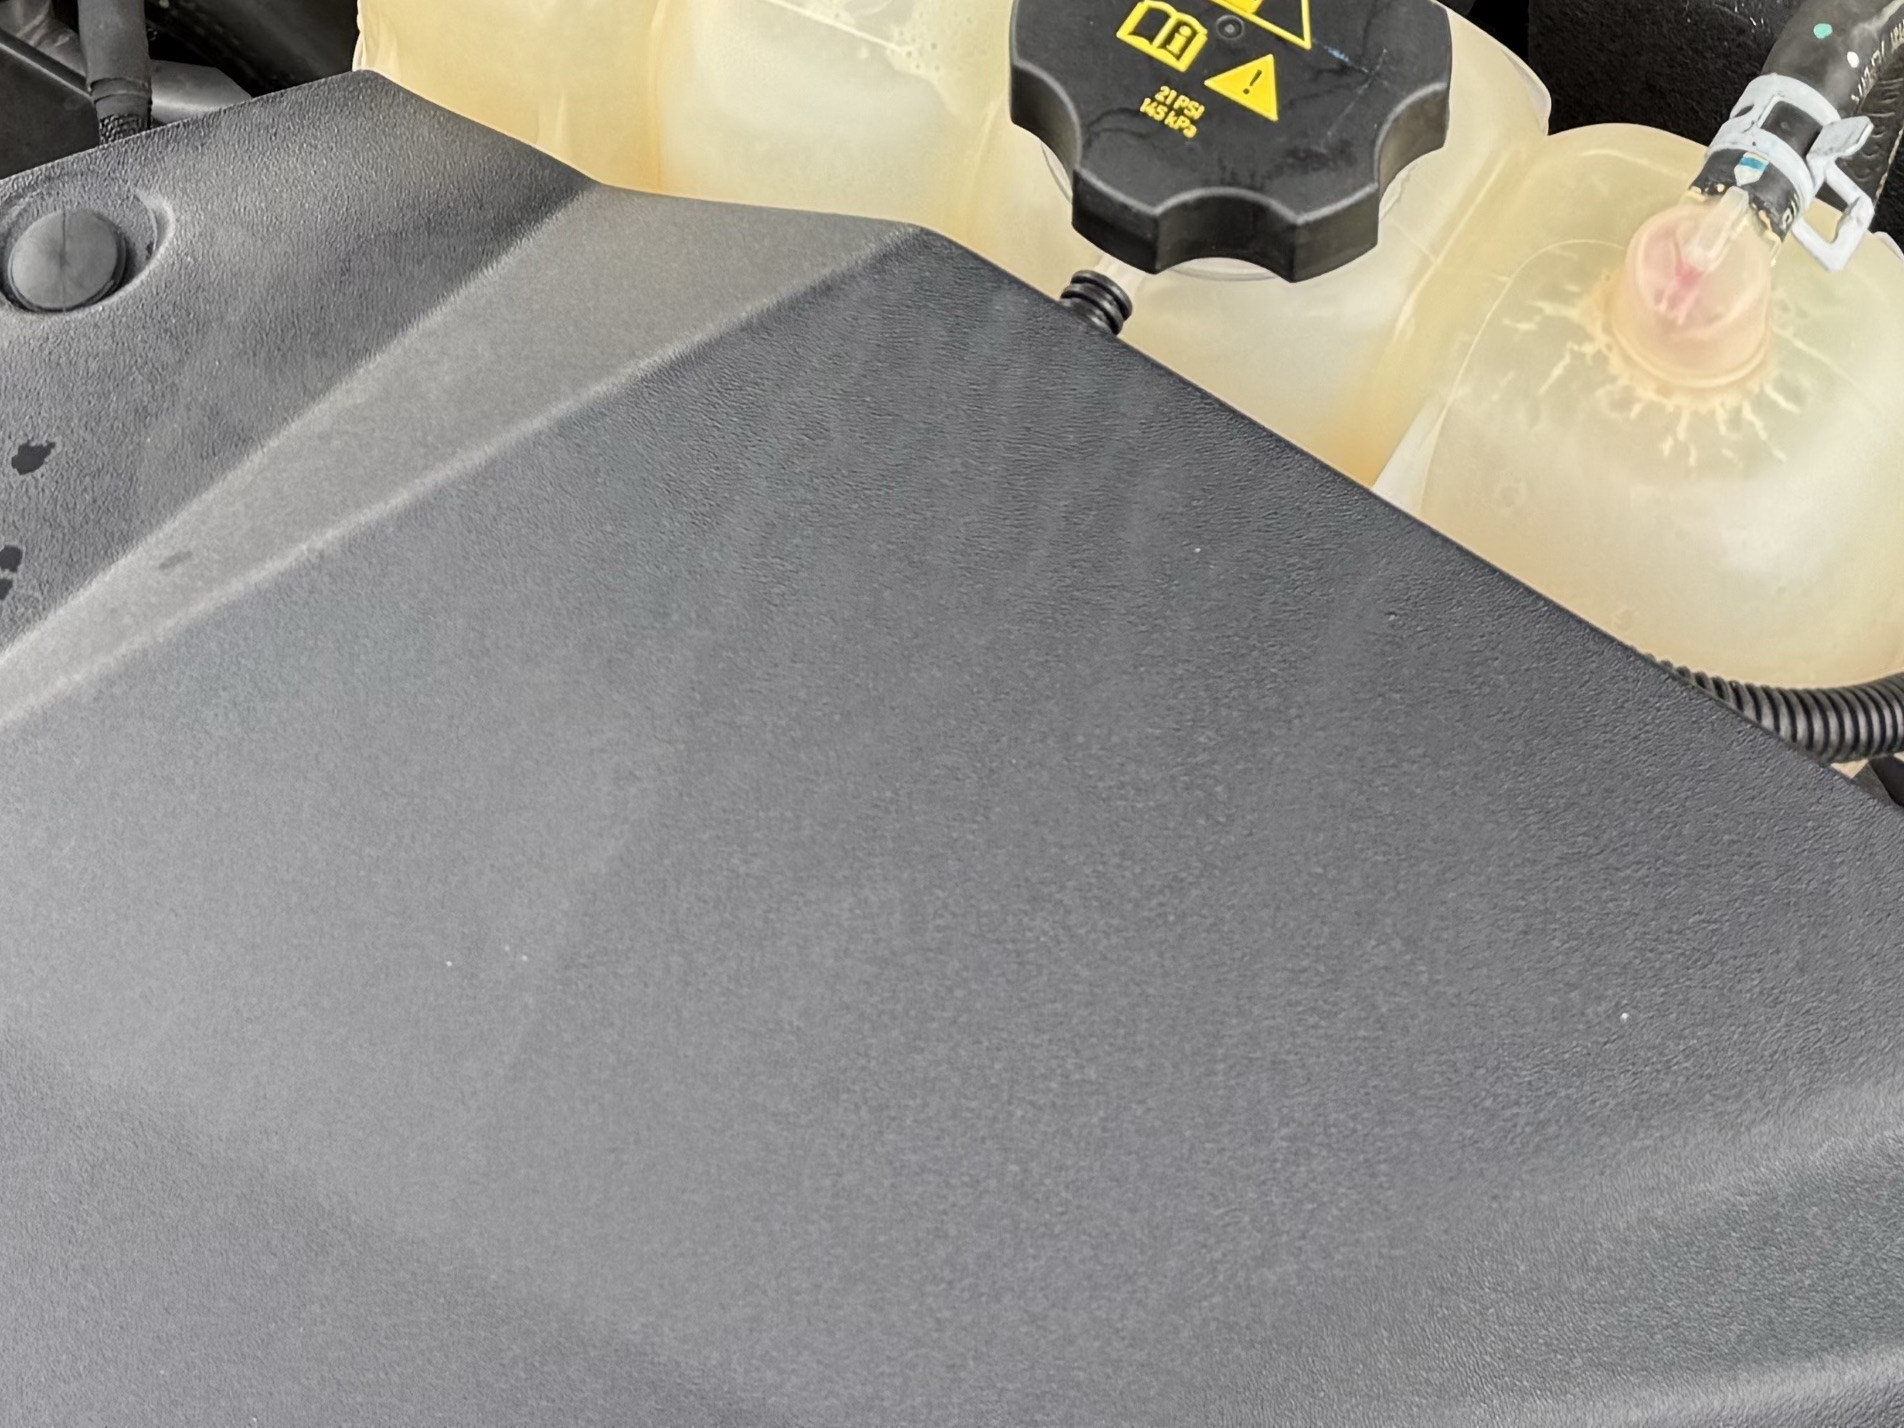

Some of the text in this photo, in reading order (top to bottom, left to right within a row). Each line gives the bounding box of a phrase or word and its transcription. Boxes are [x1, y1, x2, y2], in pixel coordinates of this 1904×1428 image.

[1139, 97, 1198, 139] 145 kPa
[1154, 85, 1206, 121] 21 PSI
